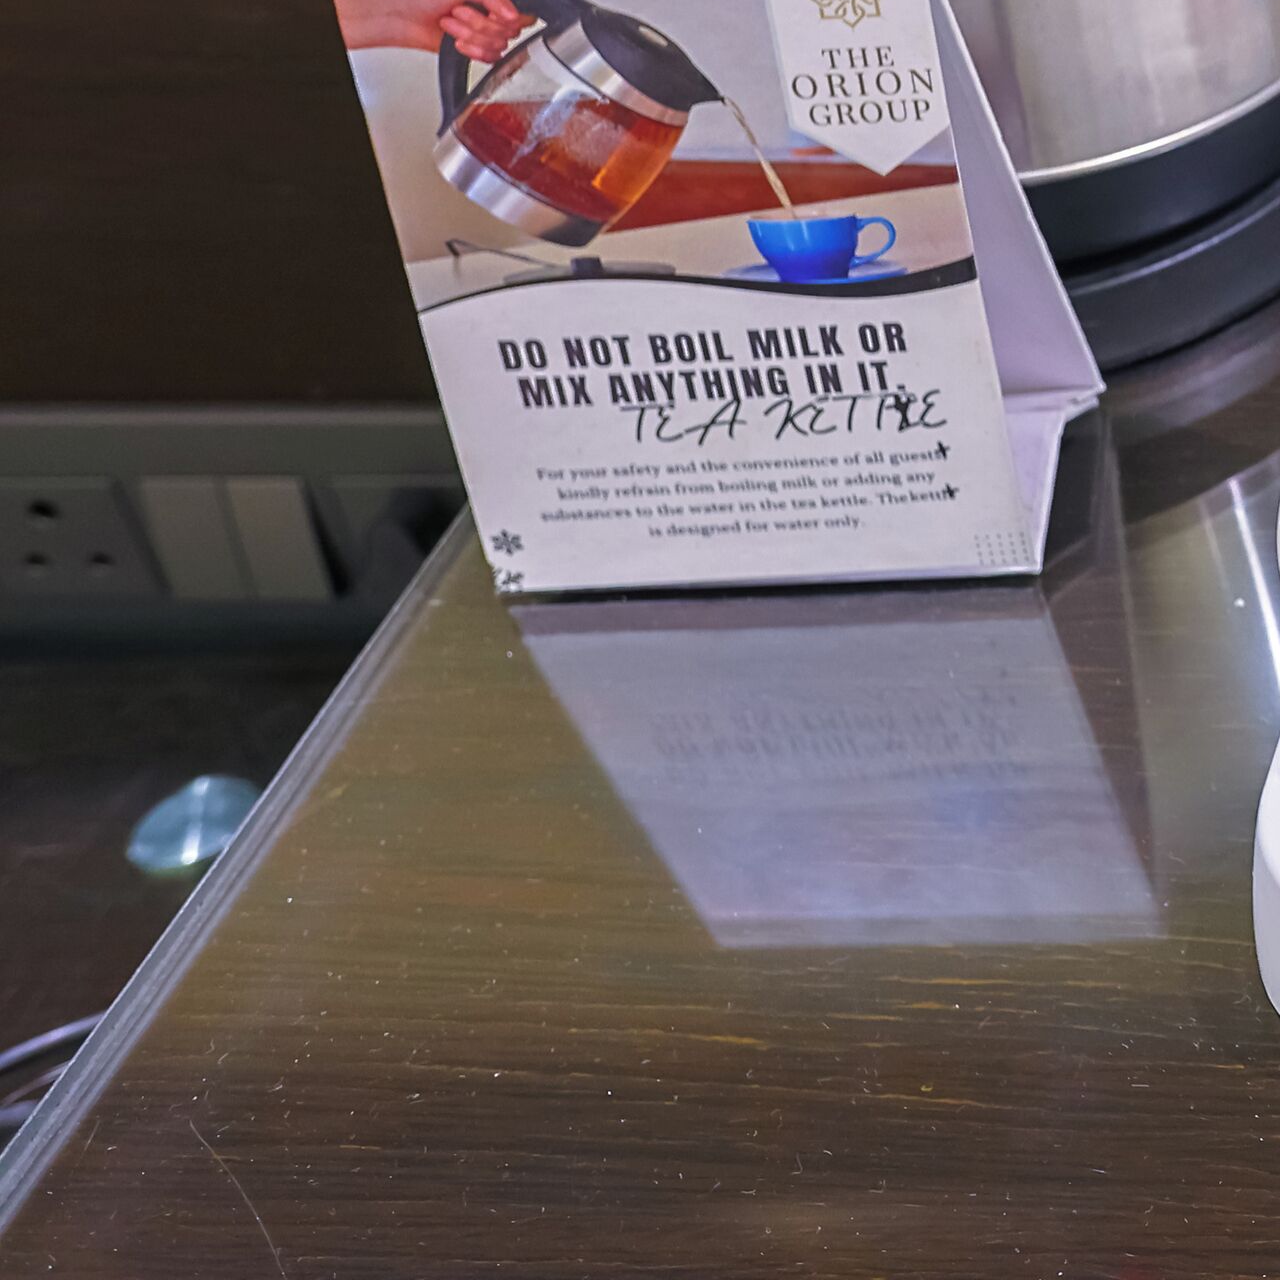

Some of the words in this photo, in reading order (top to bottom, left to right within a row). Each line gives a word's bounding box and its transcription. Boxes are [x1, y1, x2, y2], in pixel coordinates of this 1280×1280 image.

[820, 46, 895, 70] THE
[791, 68, 935, 101] ORION
[808, 98, 931, 127] GROUP
[498, 339, 548, 370] DO
[562, 335, 632, 368] NOT
[648, 330, 735, 364] BOIL
[746, 324, 845, 360] MILK
[857, 322, 908, 354] OR
[517, 376, 594, 408] MIX
[608, 366, 791, 404] ANYTHING
[803, 361, 844, 394] IN
[619, 396, 747, 446] TEA
[536, 467, 565, 481] For
[570, 468, 608, 483] your
[612, 462, 661, 479] safety
[666, 459, 697, 475] and
[701, 458, 729, 473] the
[732, 452, 839, 471] convenience
[843, 451, 860, 466] of
[864, 449, 885, 465] all
[556, 485, 610, 501] kindly
[614, 482, 671, 498] refrain
[674, 480, 715, 494] from
[718, 477, 778, 494] boiling
[781, 475, 818, 490] milk
[821, 476, 839, 487] or
[844, 471, 902, 487] adding
[905, 470, 936, 486] any
[540, 507, 632, 523] substances
[635, 506, 654, 518] to
[656, 503, 685, 517] the
[689, 502, 734, 515] water
[739, 500, 756, 512] in
[759, 497, 787, 511] the
[791, 496, 816, 509] tea
[648, 526, 663, 537] is
[666, 520, 741, 537] designed
[745, 519, 769, 532] for
[773, 517, 819, 531] water
